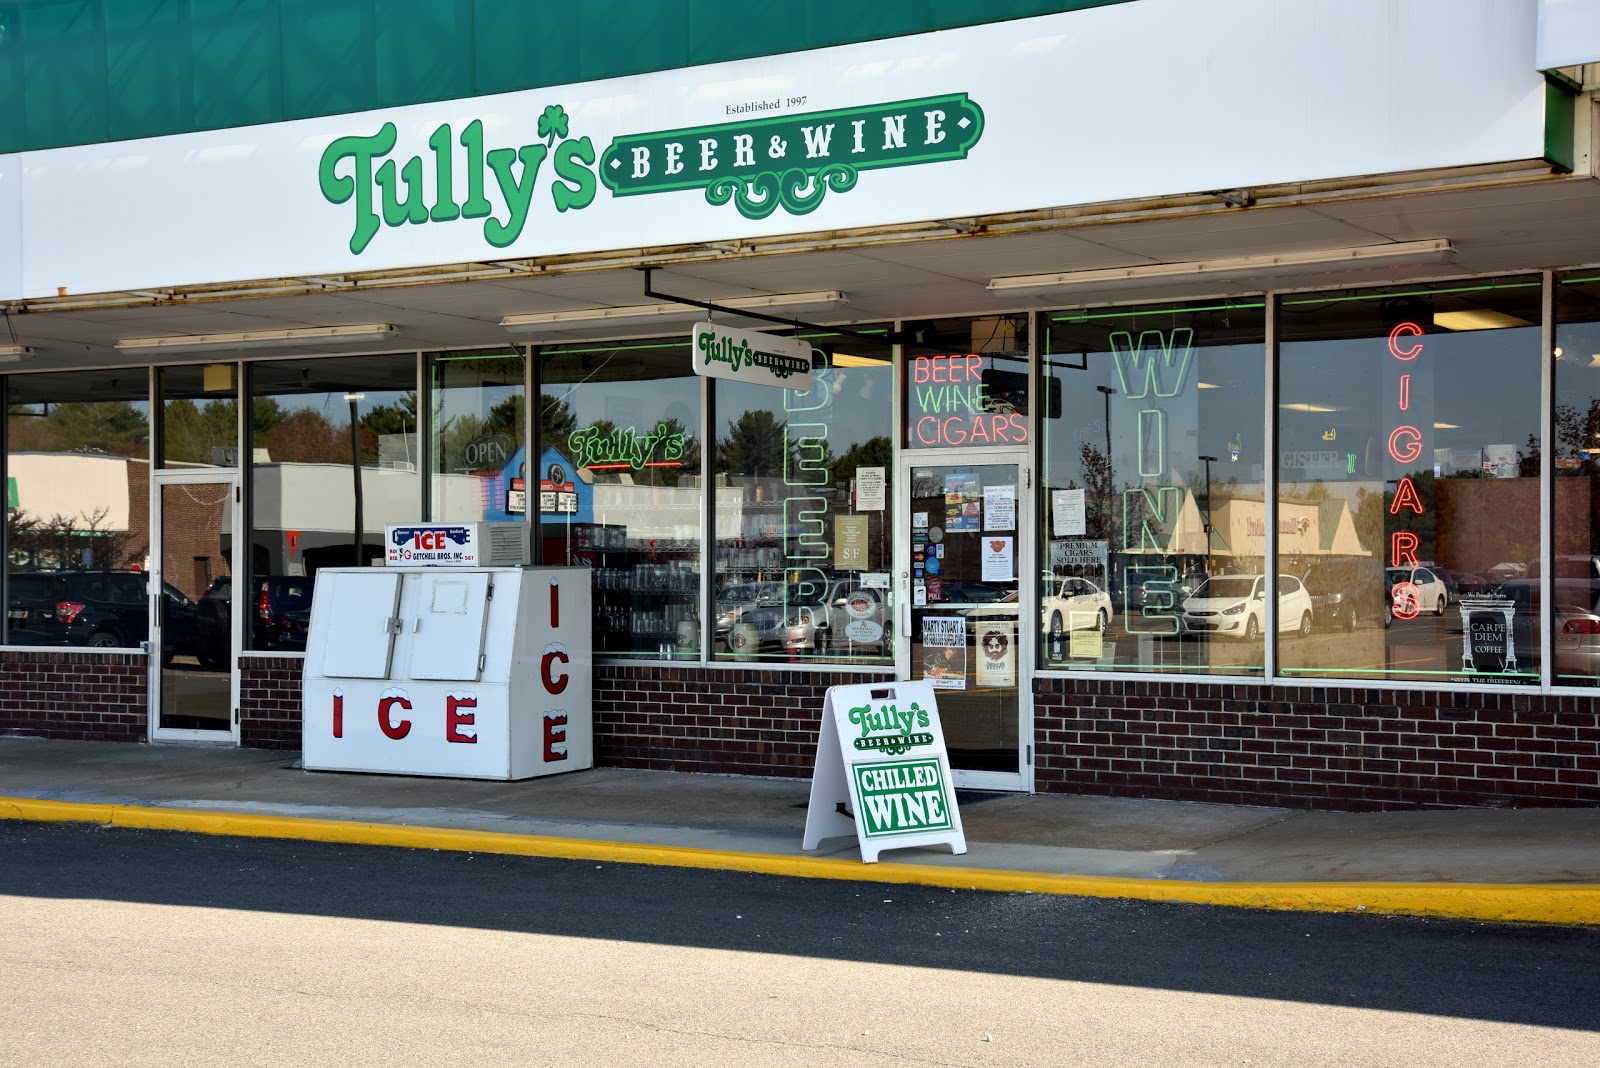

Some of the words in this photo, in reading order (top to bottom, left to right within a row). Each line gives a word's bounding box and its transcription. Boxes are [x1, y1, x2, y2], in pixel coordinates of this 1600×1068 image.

[724, 98, 781, 116] Established
[785, 95, 808, 108] 1997
[631, 132, 757, 180] BEER
[767, 137, 788, 159] &
[801, 109, 950, 159] WINE
[318, 104, 597, 256] Tully's
[698, 331, 753, 373] Tully's
[757, 353, 779, 367] BEER
[784, 358, 806, 371] WINE
[914, 354, 983, 383] BEER
[916, 383, 991, 413] WINE
[917, 412, 1028, 446] CIGARS
[465, 441, 507, 465] OPEN
[567, 423, 686, 471] Tully's
[1108, 326, 1194, 636] WINE
[1387, 321, 1424, 621] CIGARS
[413, 530, 447, 551] ICE
[1059, 541, 1098, 549] PREMIUM
[1064, 549, 1094, 557] CIGARS
[412, 552, 436, 561] GETCHELL
[437, 552, 453, 560] BROS.
[453, 552, 464, 560] INC.
[1056, 556, 1078, 564] SOLD
[1079, 556, 1102, 564] HERE
[923, 620, 940, 633] MARTY
[940, 620, 960, 633] STUART
[960, 620, 964, 633] &
[1470, 623, 1506, 632] CARPE
[1474, 632, 1503, 641] DIEM
[1474, 645, 1503, 654] COFFEE
[541, 576, 570, 763] ICE
[332, 686, 478, 744] ICE
[848, 702, 930, 737] Tully's
[860, 738, 889, 748] BEER
[898, 735, 928, 745] WINE
[861, 765, 938, 791] CHILLED
[864, 790, 946, 830] WINE
